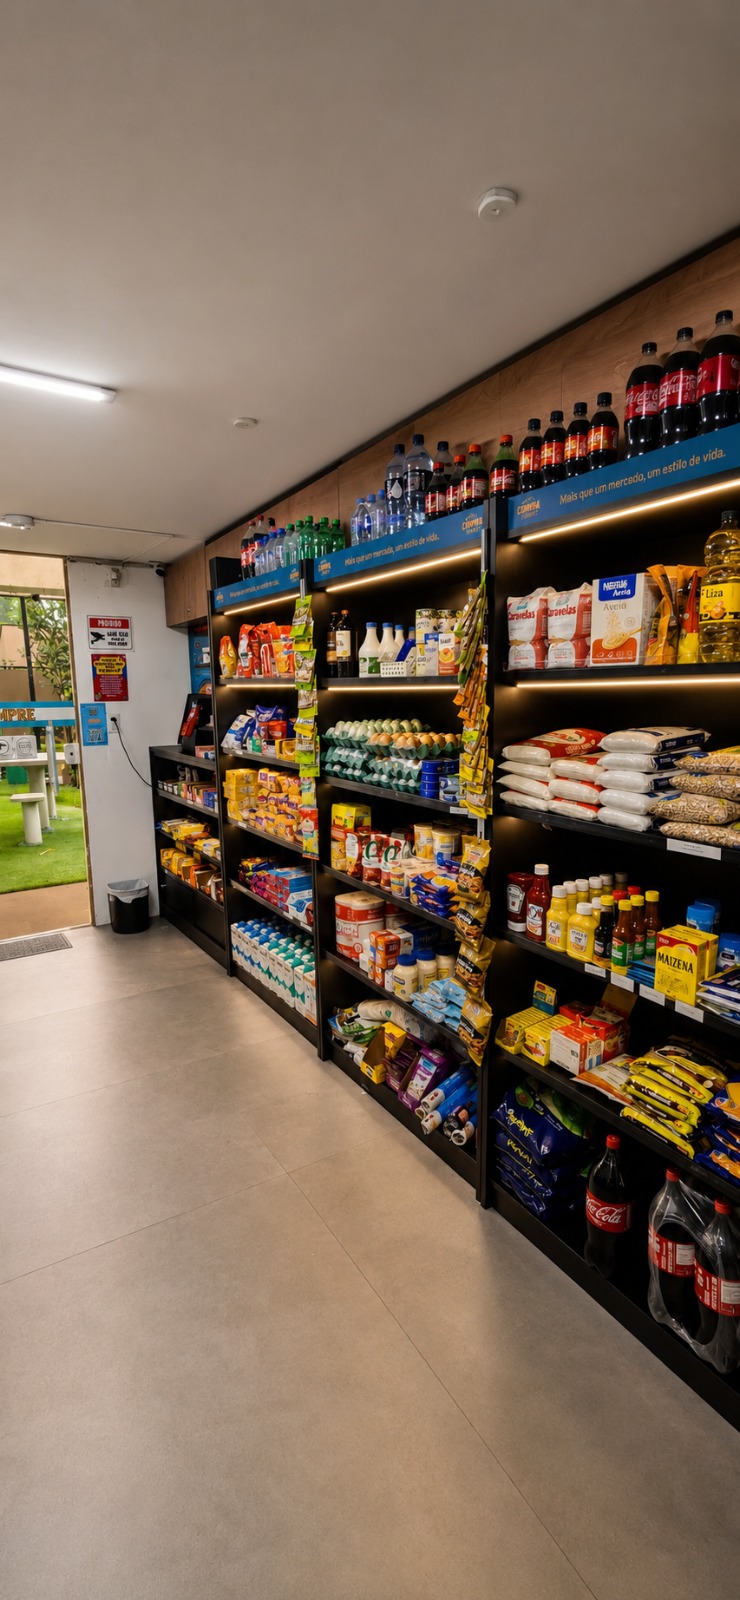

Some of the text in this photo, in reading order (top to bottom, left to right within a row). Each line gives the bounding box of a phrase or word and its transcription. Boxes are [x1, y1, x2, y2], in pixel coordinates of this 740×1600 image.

[559, 490, 578, 506] Mais
[579, 488, 594, 502] que
[594, 484, 607, 496] um
[647, 468, 661, 480] um
[662, 459, 688, 475] estilo
[689, 455, 702, 468] de
[703, 447, 727, 463] vida.
[706, 588, 723, 599] Liza
[657, 951, 694, 975] MAIZENA
